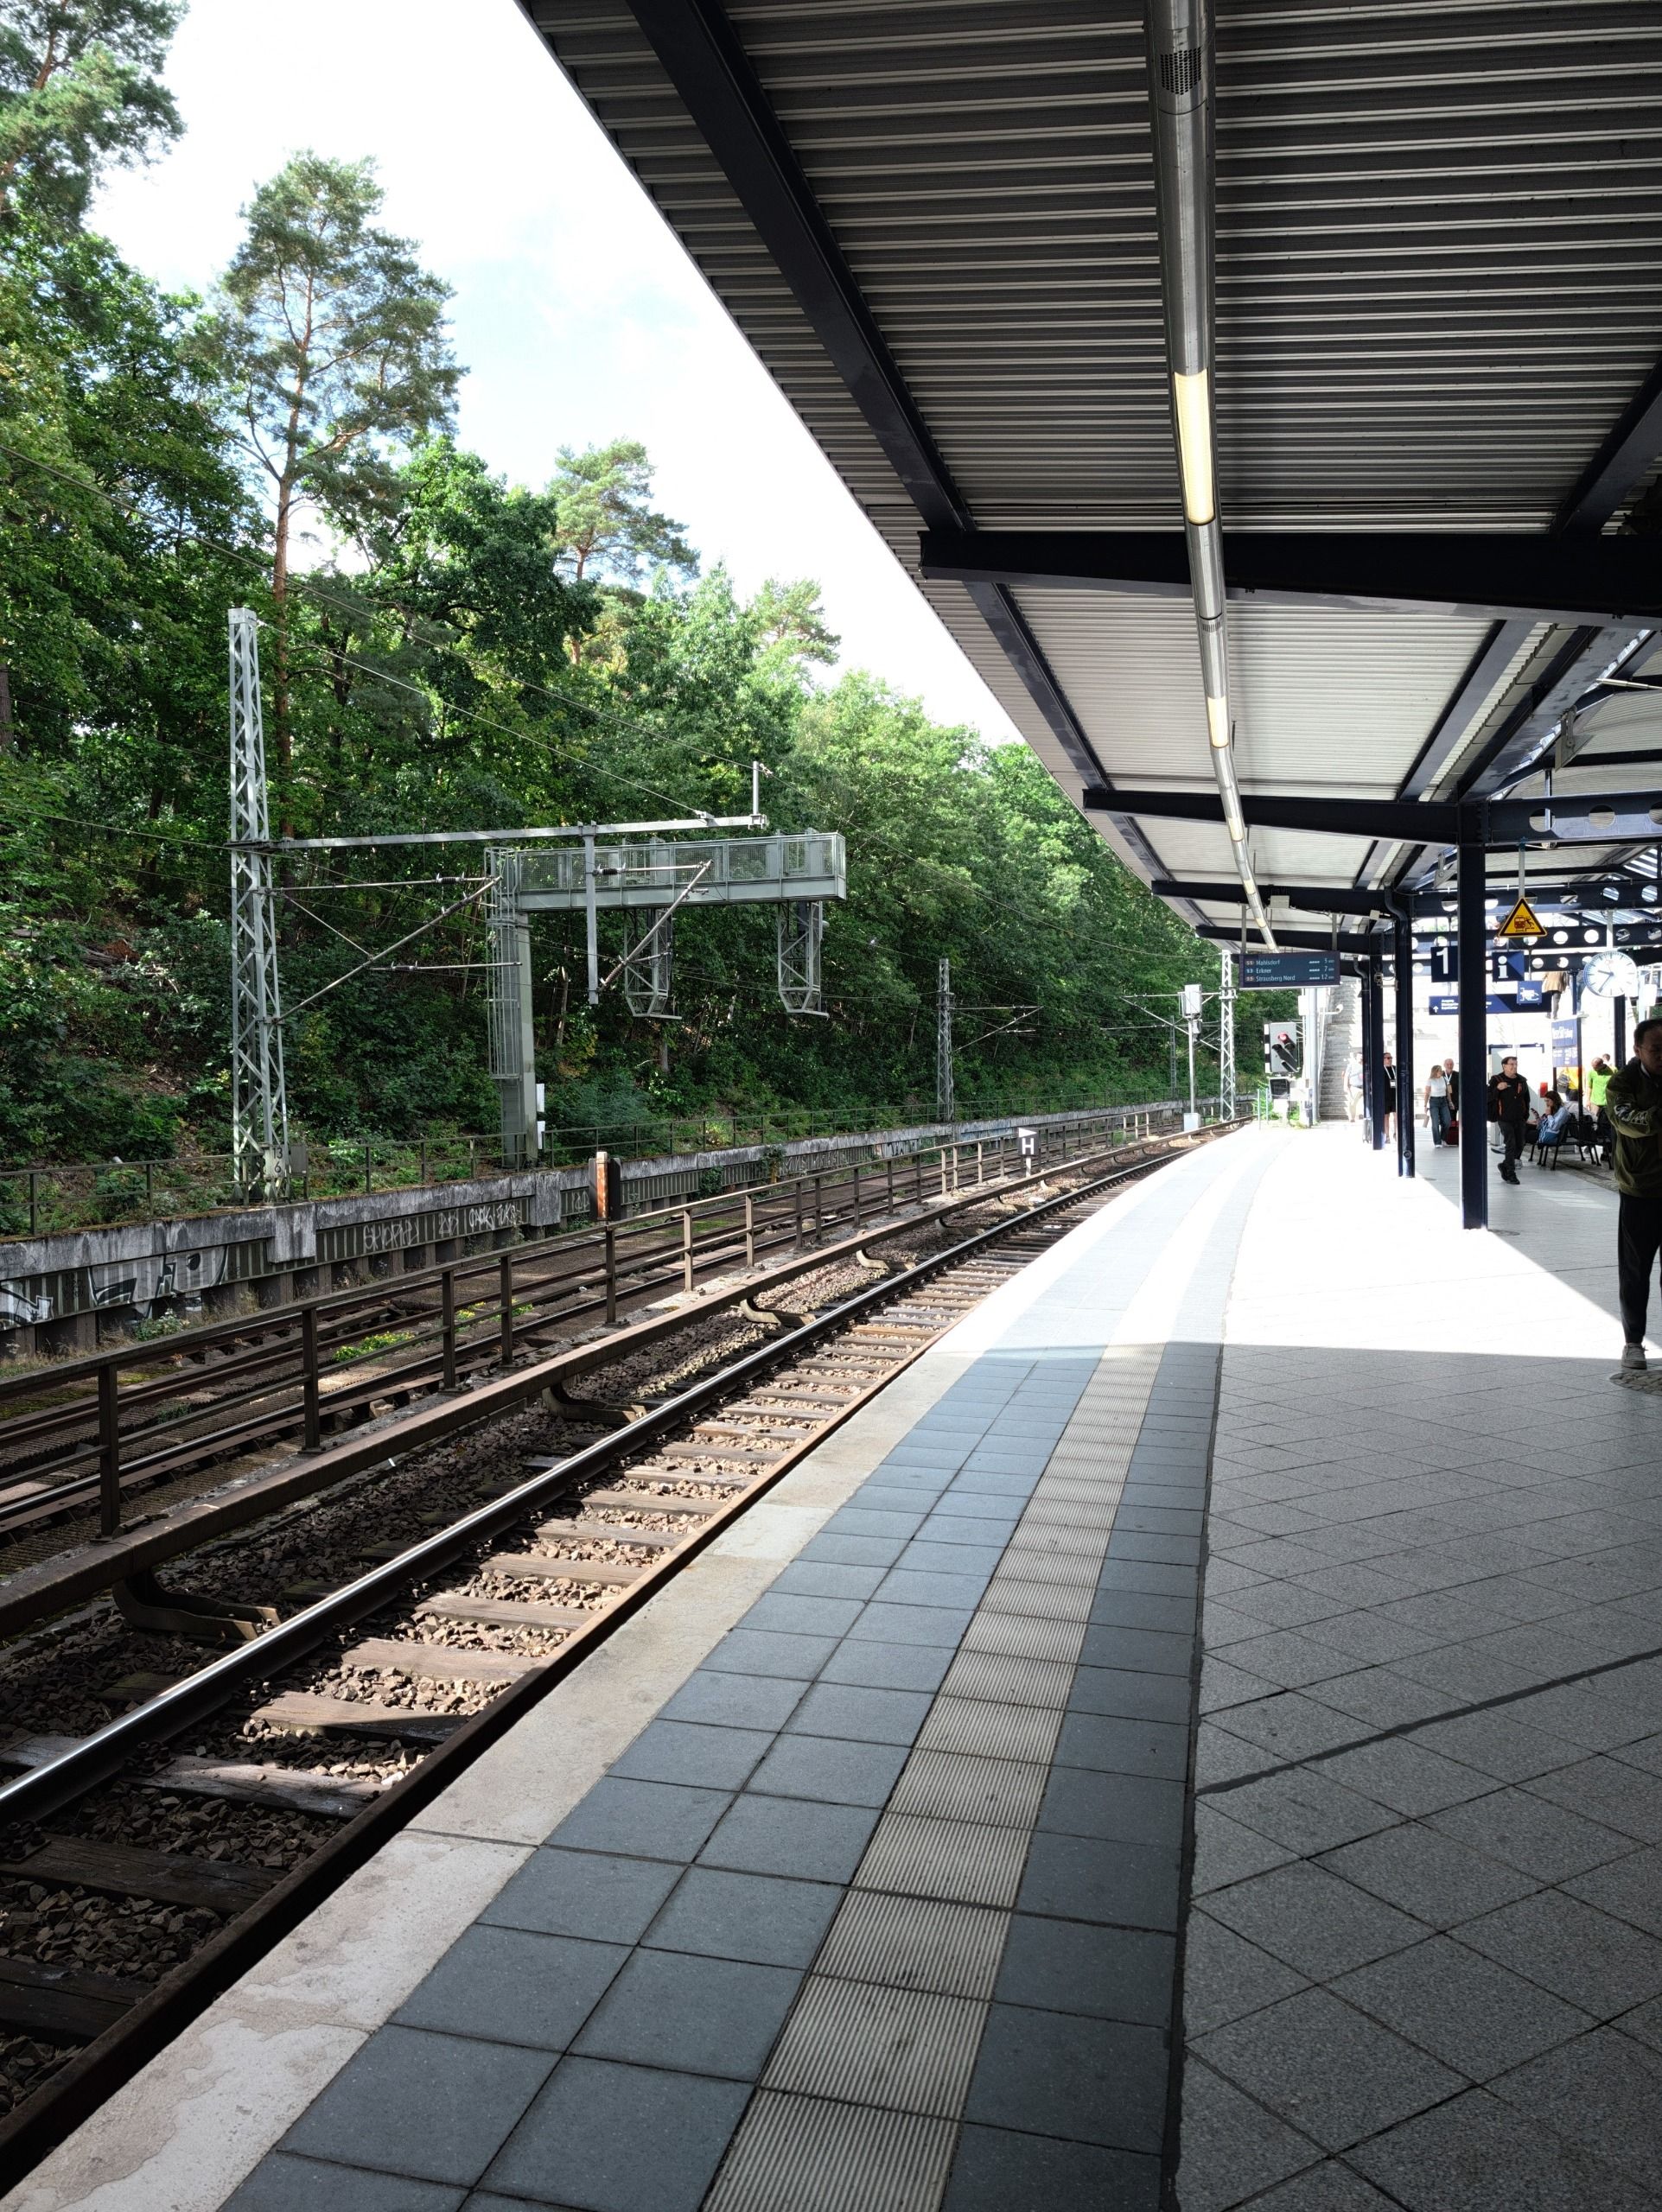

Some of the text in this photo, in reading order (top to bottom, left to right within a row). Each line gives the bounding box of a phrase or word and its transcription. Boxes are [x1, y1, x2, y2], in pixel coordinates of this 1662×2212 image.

[1436, 947, 1449, 975] 1
[271, 1147, 283, 1160] 13
[1022, 1137, 1035, 1155] H
[274, 1161, 282, 1173] 6
